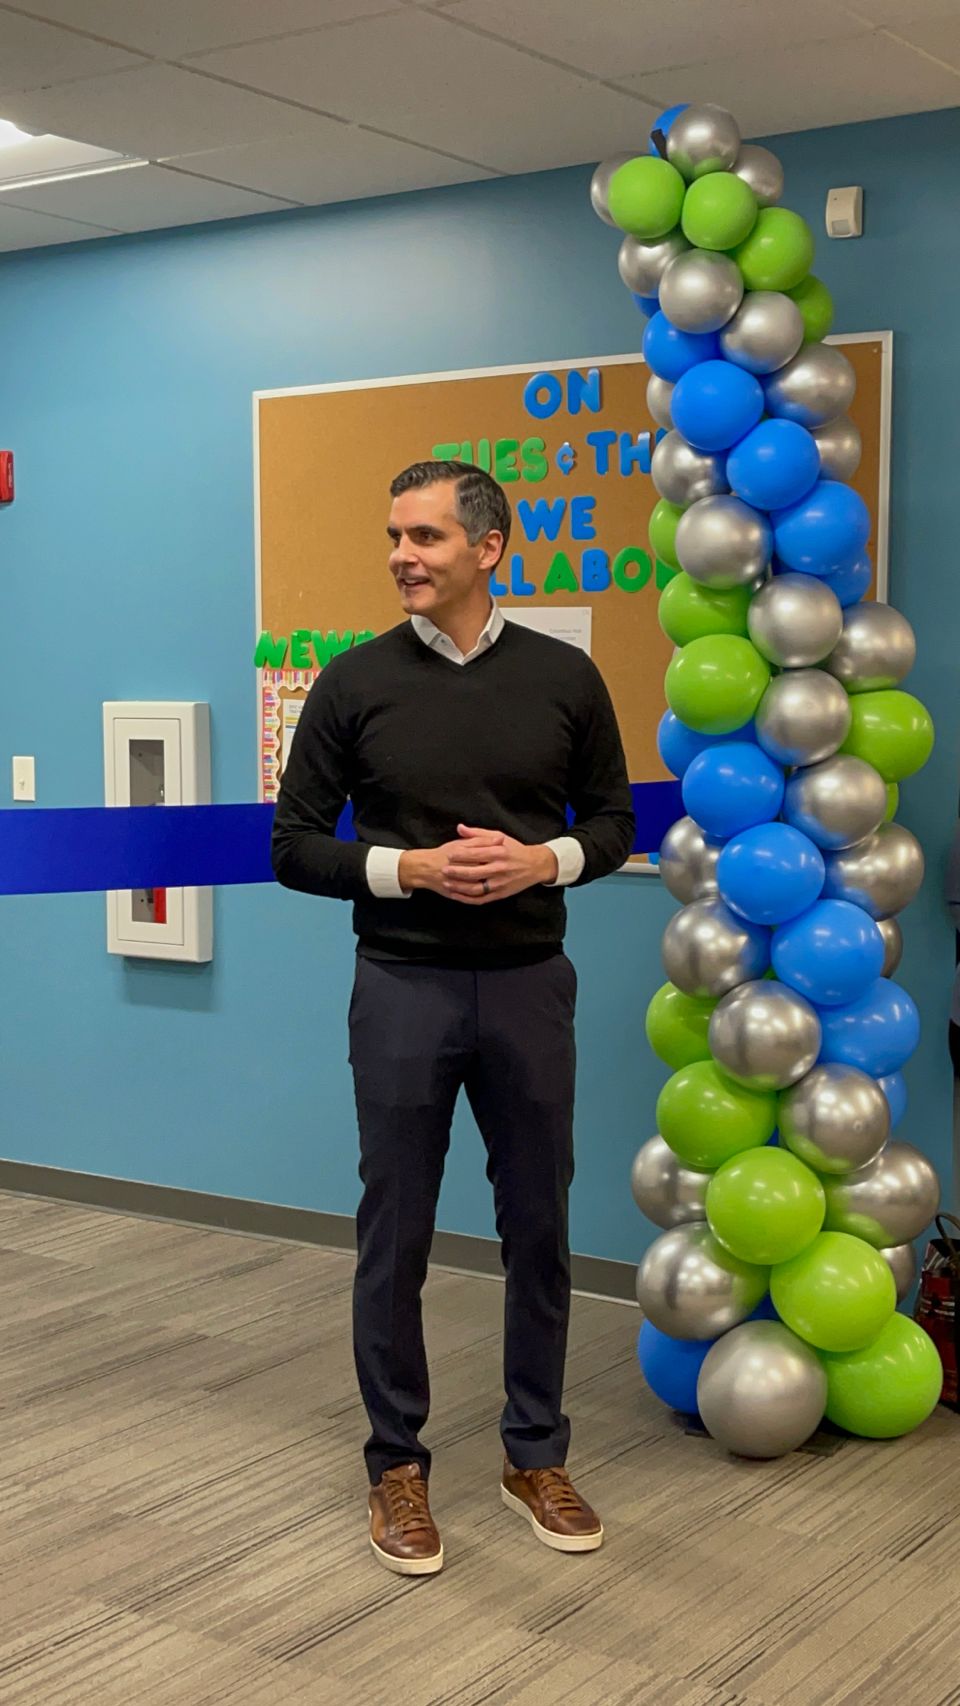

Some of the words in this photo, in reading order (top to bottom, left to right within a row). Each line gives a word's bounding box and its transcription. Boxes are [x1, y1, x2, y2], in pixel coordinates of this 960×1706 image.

[524, 369, 602, 419] ON
[586, 429, 669, 477] TH
[517, 496, 597, 542] WE
